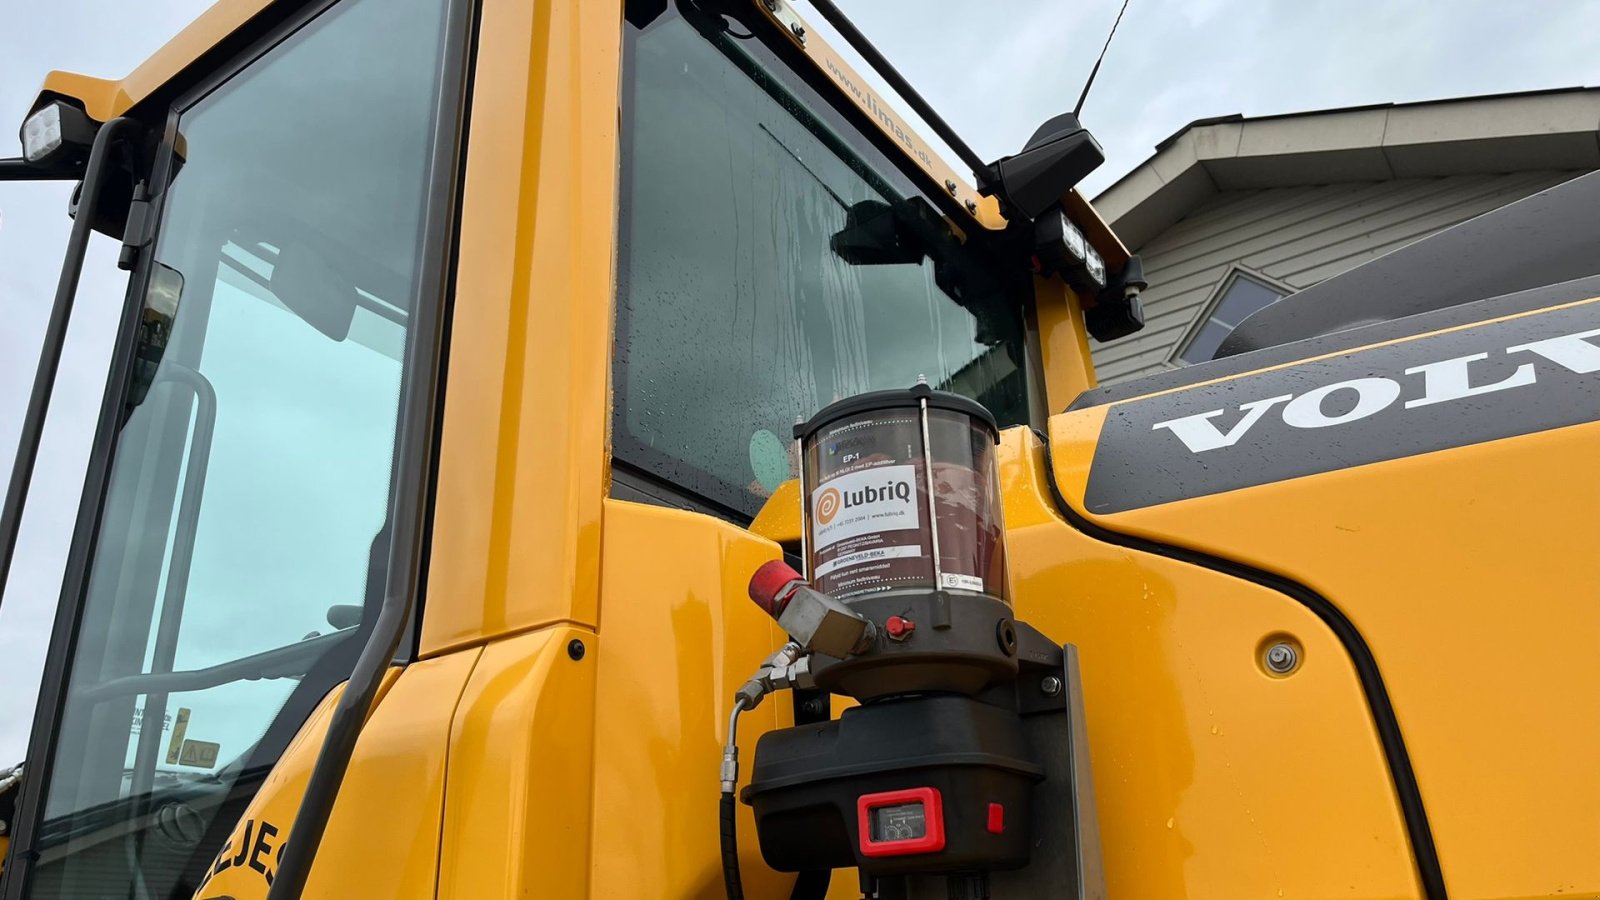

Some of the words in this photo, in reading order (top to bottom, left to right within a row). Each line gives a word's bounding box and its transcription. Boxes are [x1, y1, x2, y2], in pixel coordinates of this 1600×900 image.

[825, 57, 933, 169] www.limas.dk
[843, 452, 860, 463] EP-1
[843, 480, 911, 509] LubriQ
